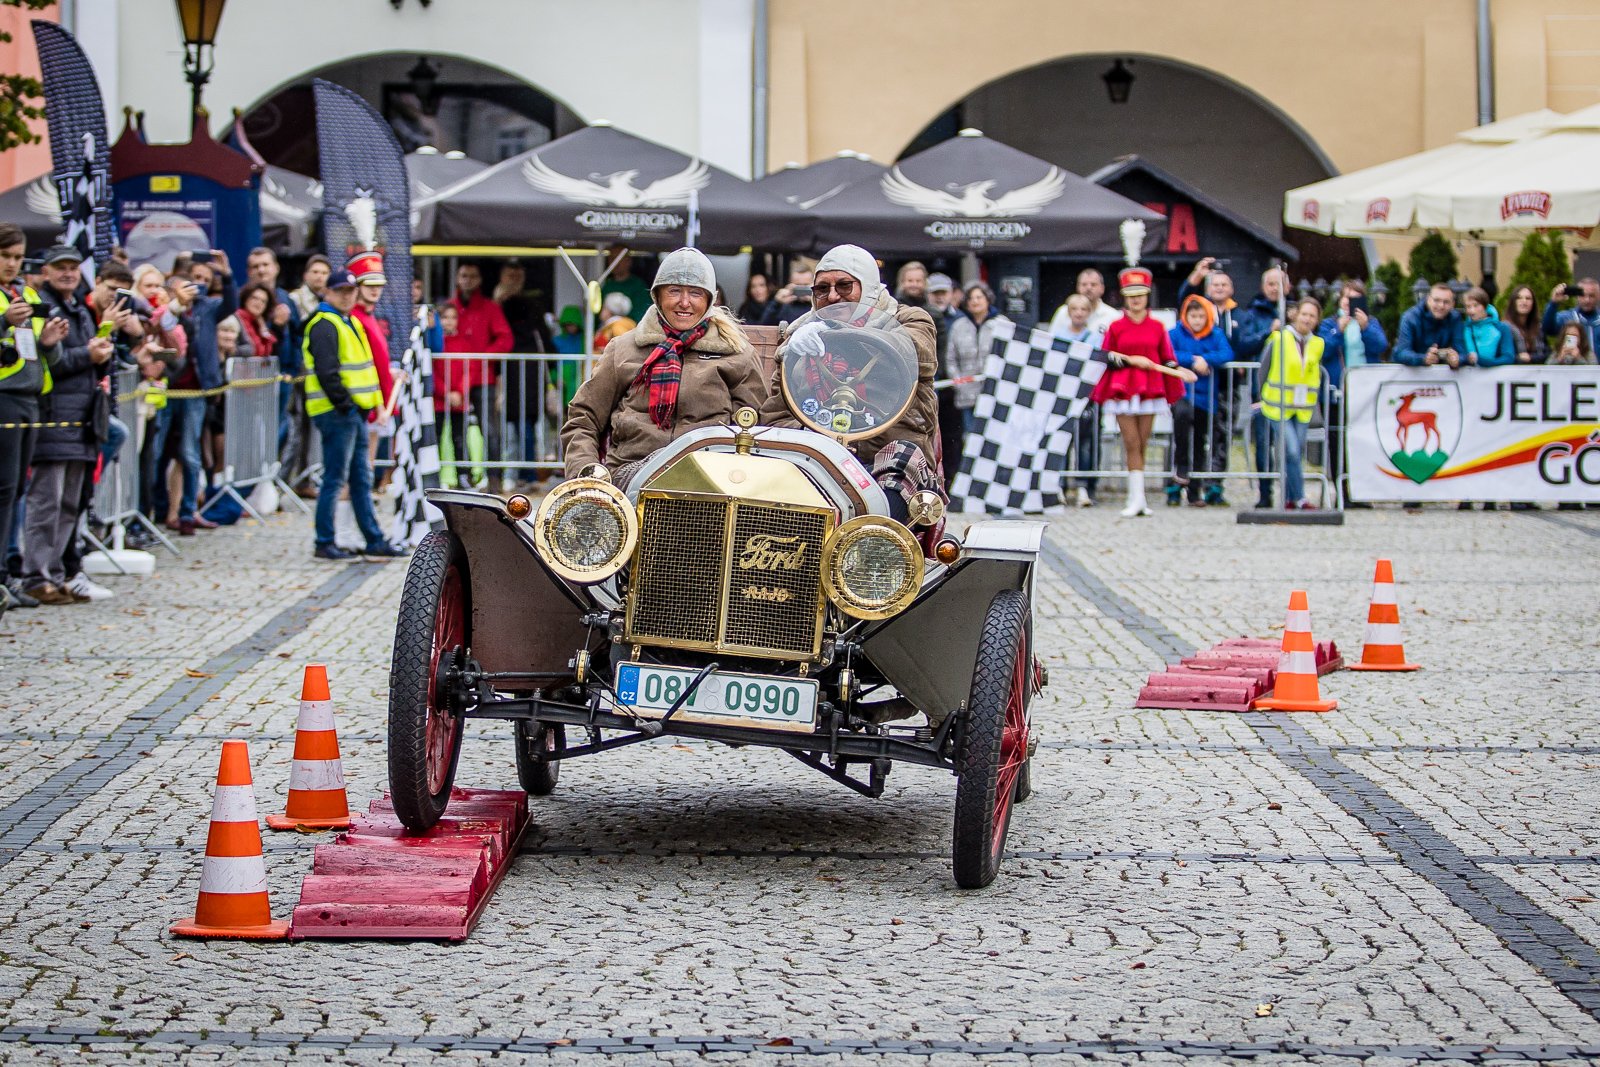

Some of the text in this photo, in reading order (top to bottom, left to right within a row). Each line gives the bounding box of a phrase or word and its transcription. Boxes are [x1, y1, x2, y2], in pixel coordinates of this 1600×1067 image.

[1480, 381, 1598, 422] JELE
[739, 534, 807, 571] Ford
[620, 690, 636, 701] CZ
[725, 680, 800, 716] 0990
